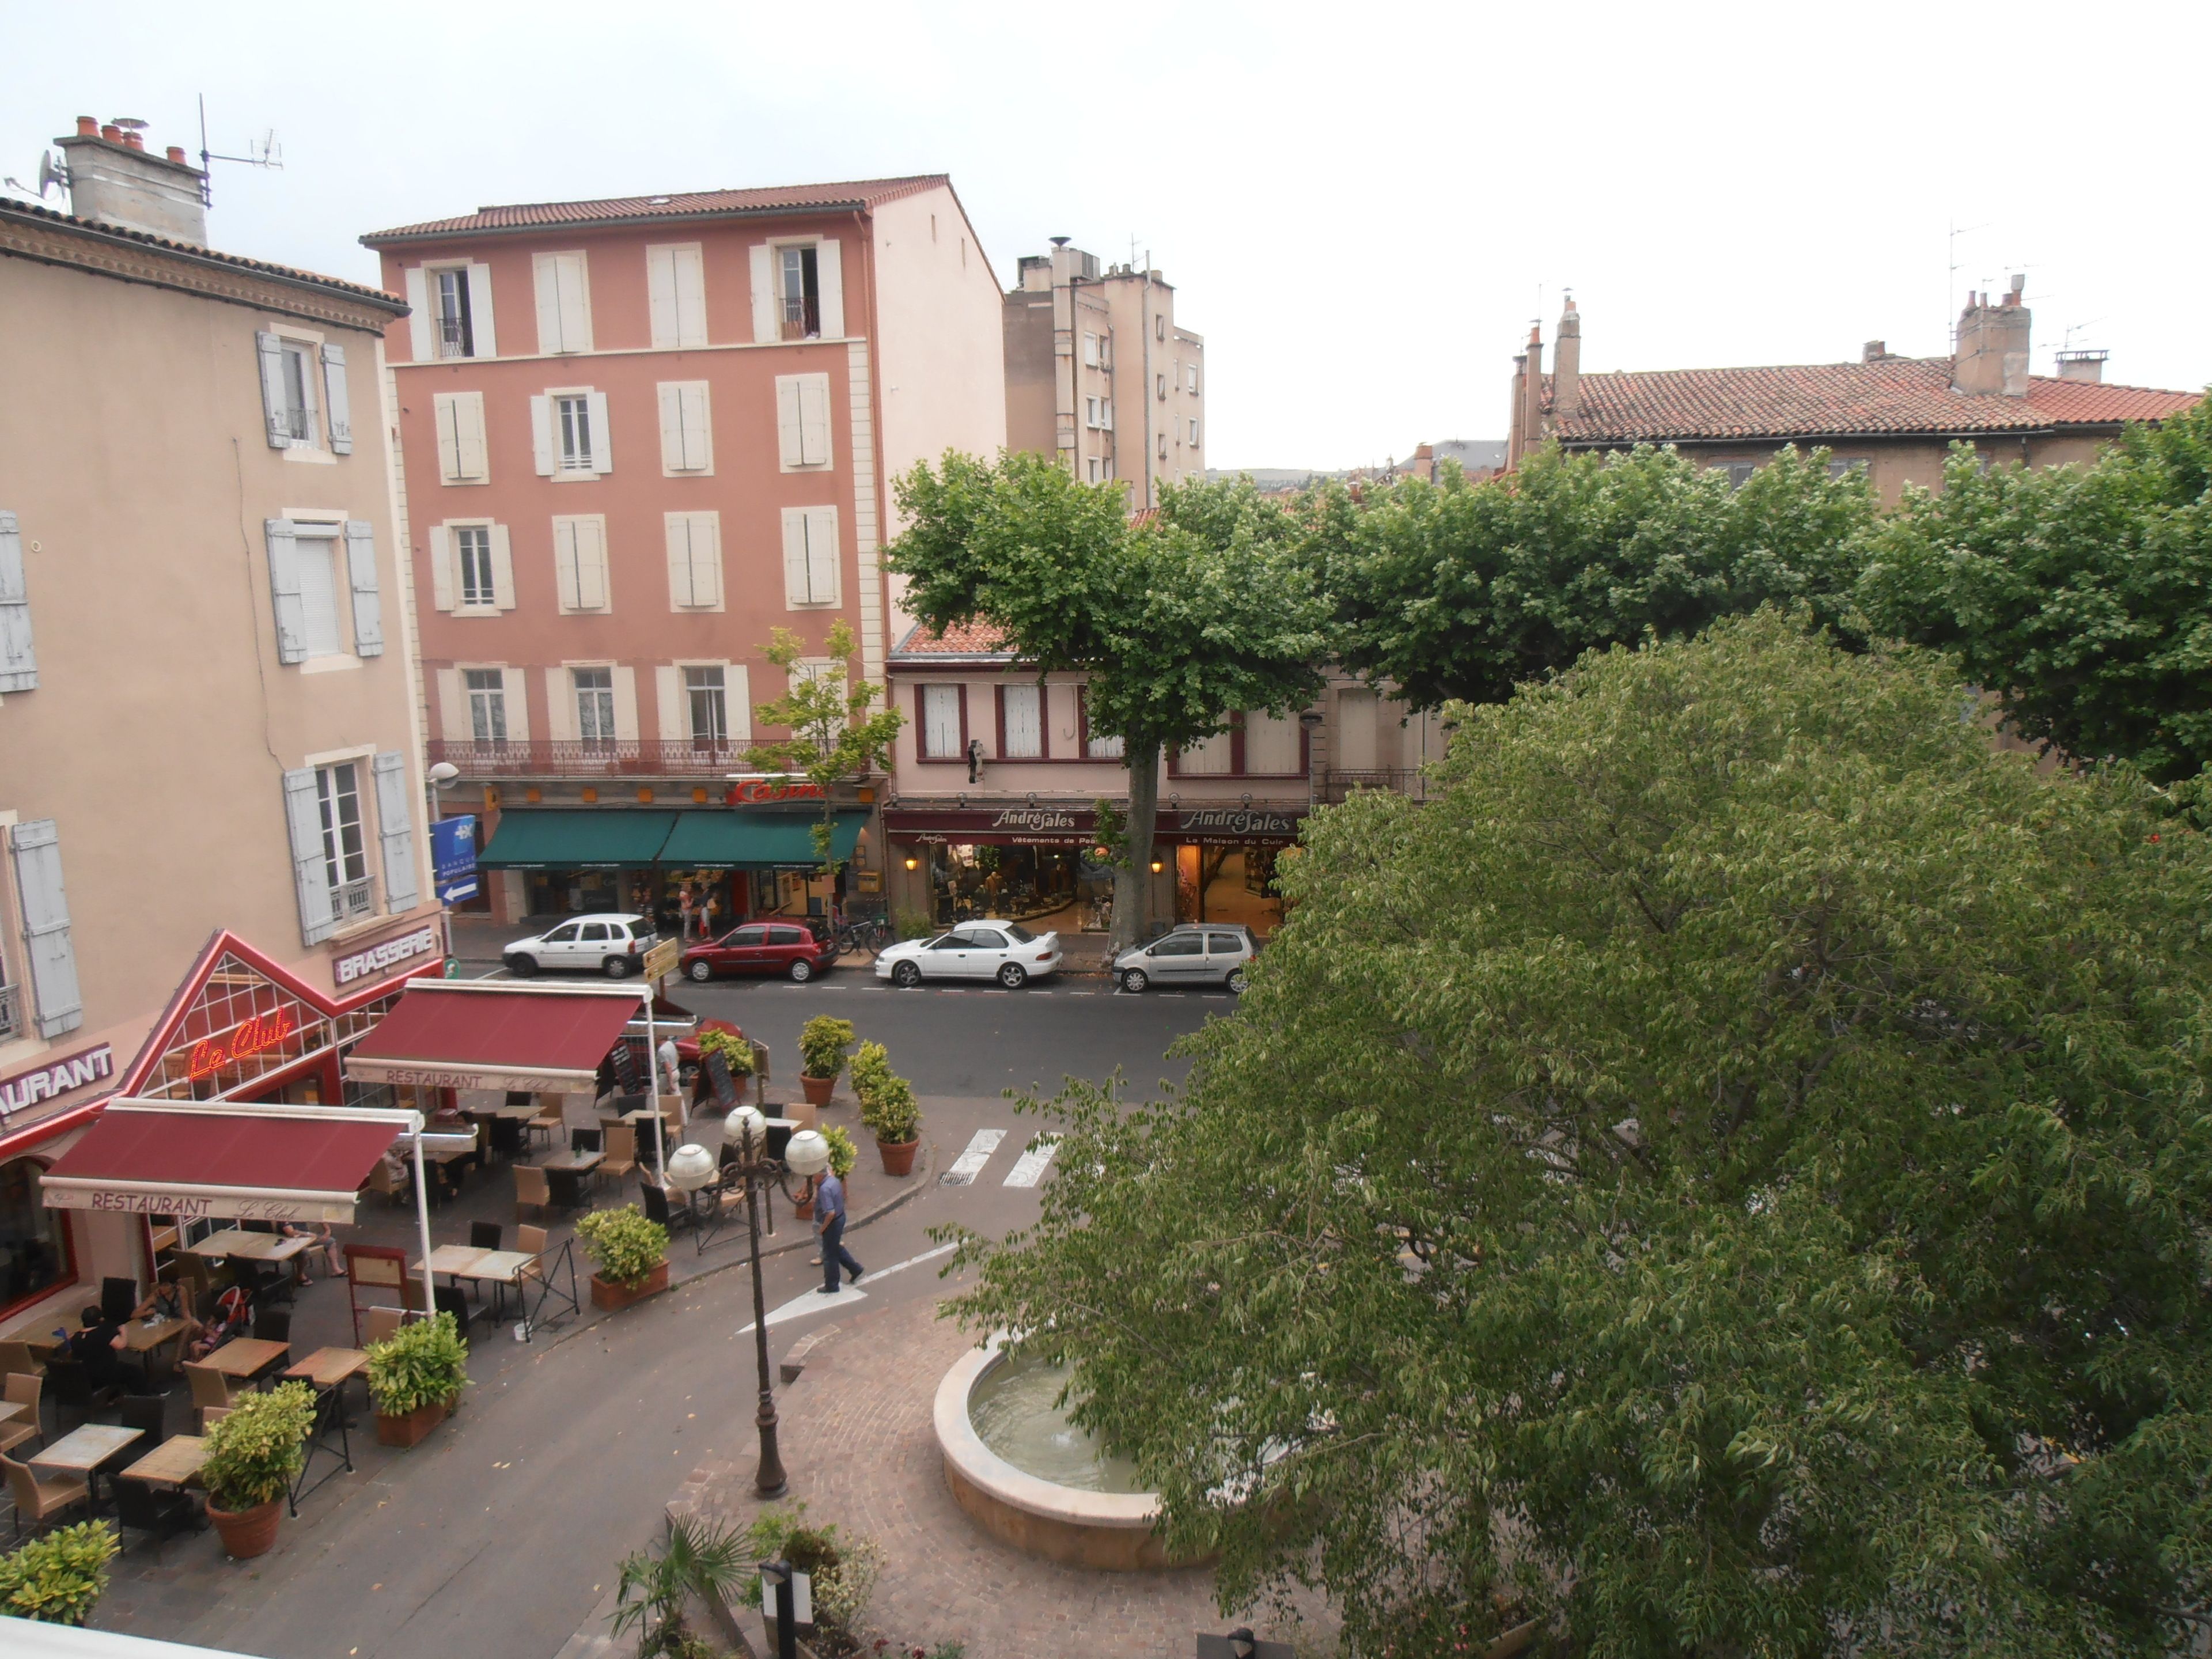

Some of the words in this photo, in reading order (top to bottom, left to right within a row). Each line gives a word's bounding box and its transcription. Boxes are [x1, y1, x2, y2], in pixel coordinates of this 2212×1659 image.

[992, 810, 1041, 827] André
[1029, 813, 1075, 831] Sales
[1232, 811, 1290, 834] Sales
[1203, 837, 1240, 845] Maison
[441, 855, 475, 869] BANQUE
[442, 862, 476, 877] POPULAIRE
[339, 927, 433, 983] BRASSERIE
[190, 1040, 225, 1081] Le
[232, 1006, 293, 1059] Club
[386, 1070, 483, 1089] RESTAURANT
[92, 1192, 213, 1215] RESTAURANT
[263, 1201, 301, 1219] Club
